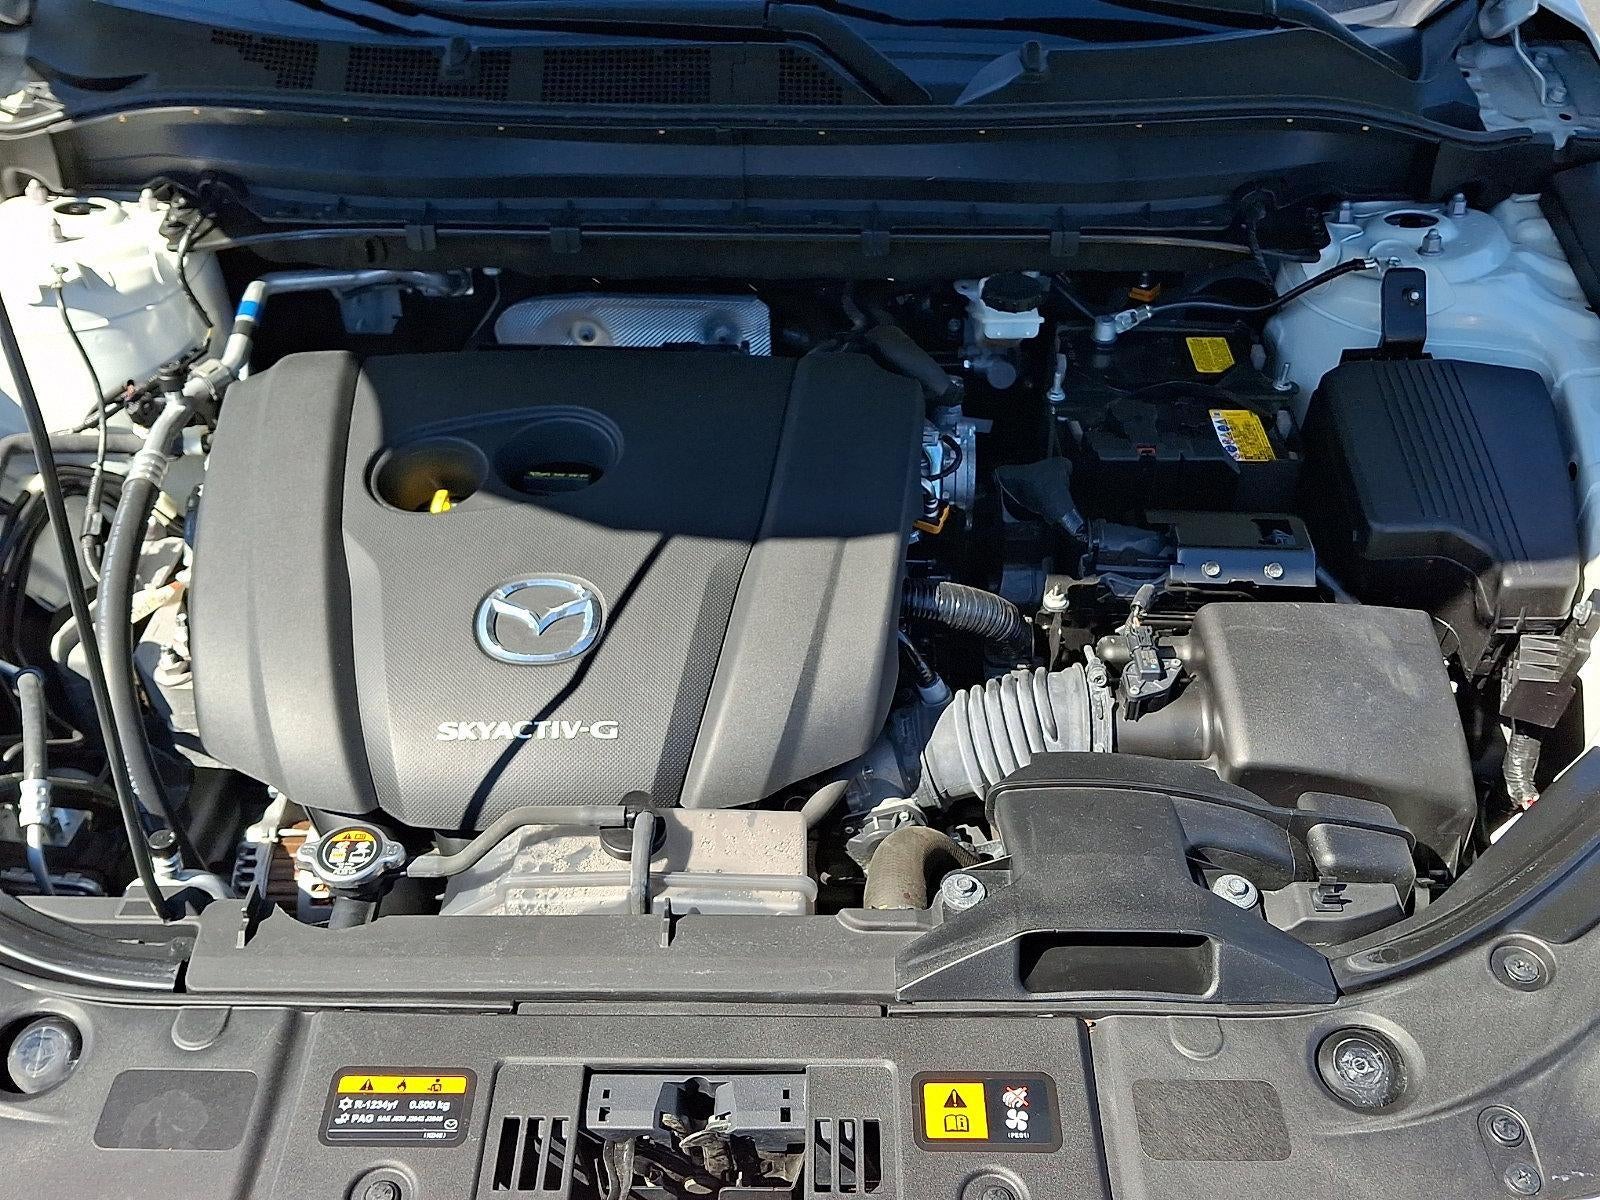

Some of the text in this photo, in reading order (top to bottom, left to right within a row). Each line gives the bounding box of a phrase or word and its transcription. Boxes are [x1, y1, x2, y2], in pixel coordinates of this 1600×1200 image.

[436, 720, 619, 741] SKYACTIV-G
[353, 1099, 399, 1111] R-1234yf
[437, 1100, 451, 1111] kg
[350, 1113, 375, 1124] PAG
